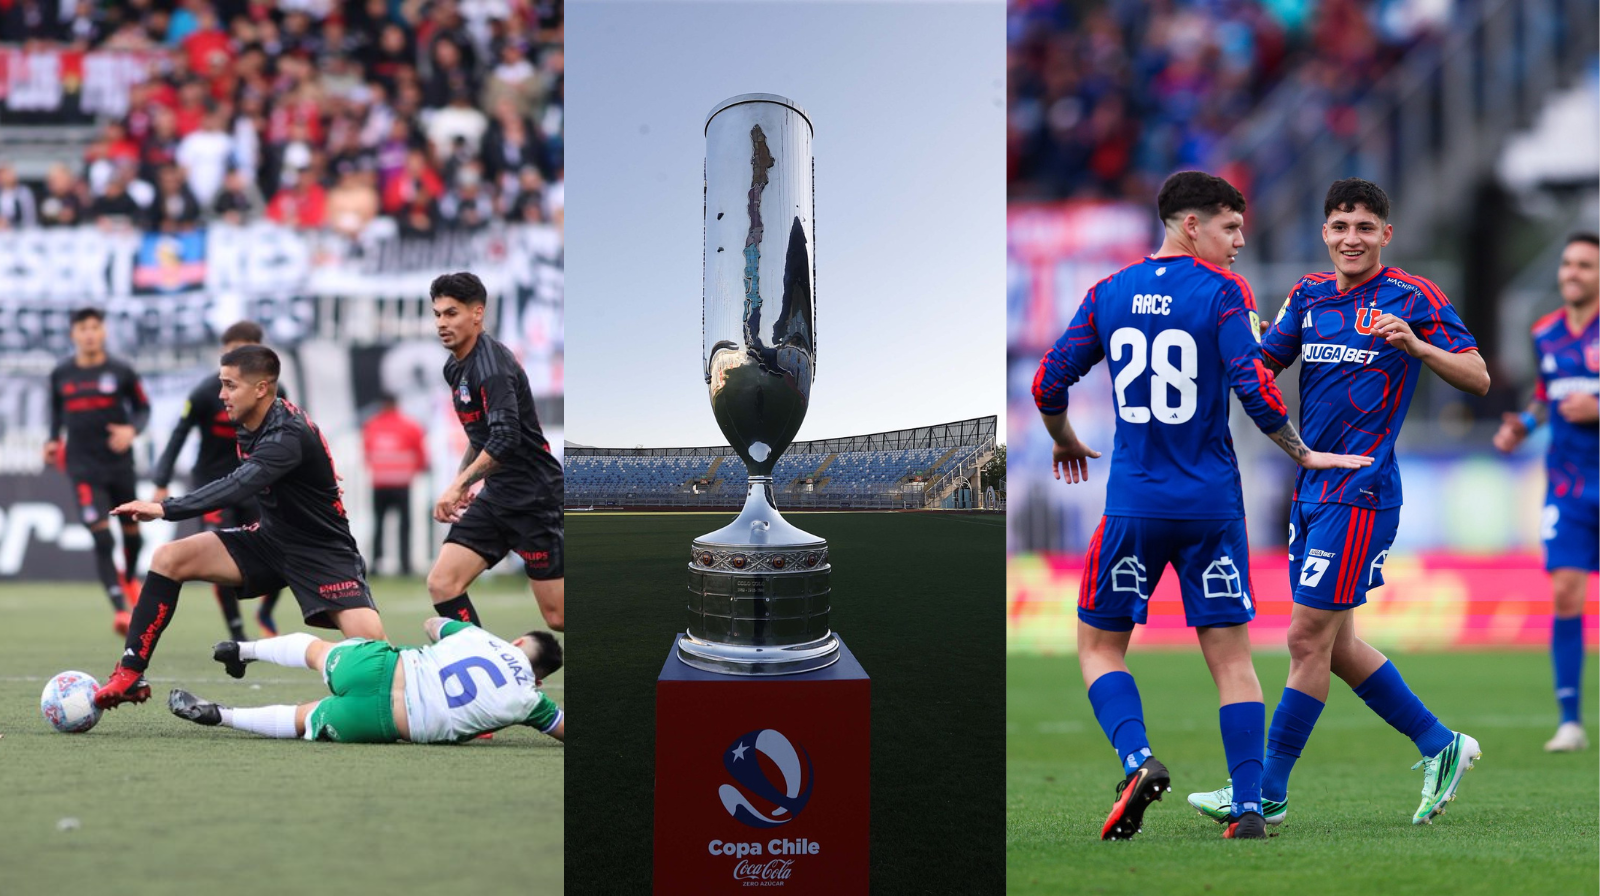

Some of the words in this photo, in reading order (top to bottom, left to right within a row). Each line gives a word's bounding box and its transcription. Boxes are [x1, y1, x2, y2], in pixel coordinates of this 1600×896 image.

[1131, 293, 1172, 316] ARCE
[1305, 344, 1379, 365] JUGABET
[1109, 326, 1198, 425] 28
[319, 580, 359, 593] PHILIPS
[500, 652, 529, 686] DIAZ
[438, 655, 508, 709] 6
[708, 839, 763, 859] Copa
[767, 838, 821, 855] Chile
[733, 859, 796, 881] Coca-Cola
